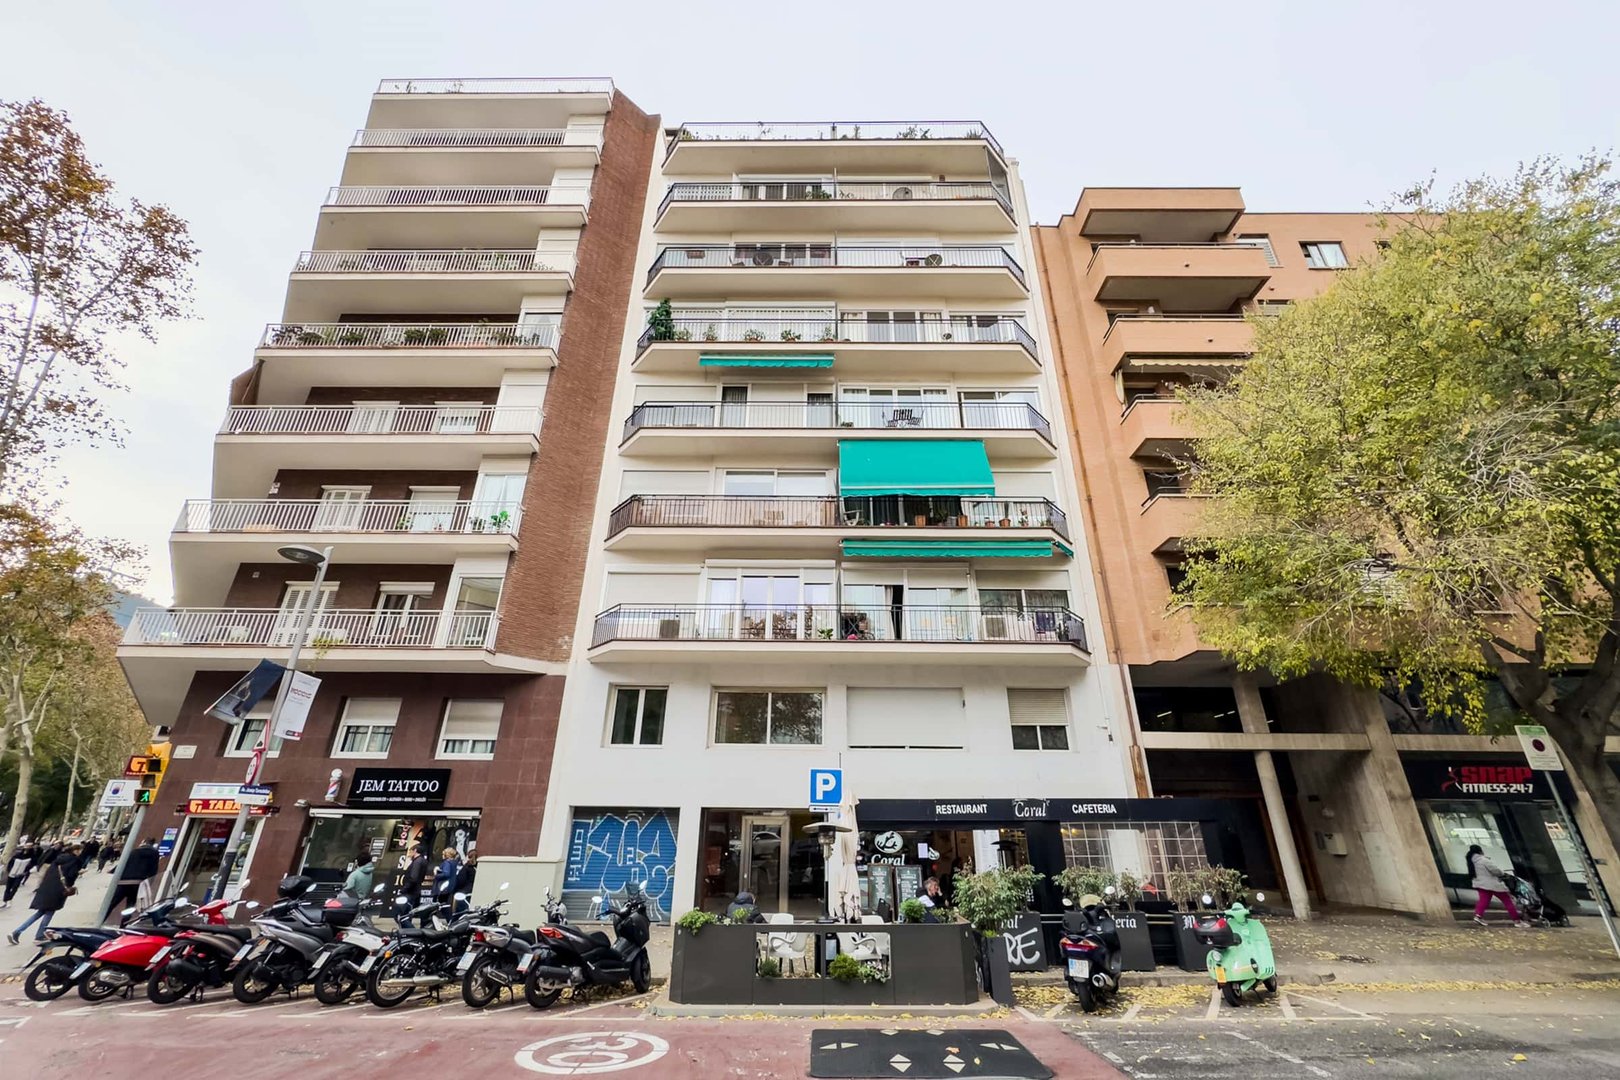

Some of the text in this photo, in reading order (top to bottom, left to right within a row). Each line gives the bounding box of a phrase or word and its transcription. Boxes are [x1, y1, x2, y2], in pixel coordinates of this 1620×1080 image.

[356, 780, 439, 793] JEM TATTOO
[816, 773, 837, 800] P
[935, 801, 1118, 818] RESTAURANT Coral CAFETERIA
[871, 854, 905, 866] Coral
